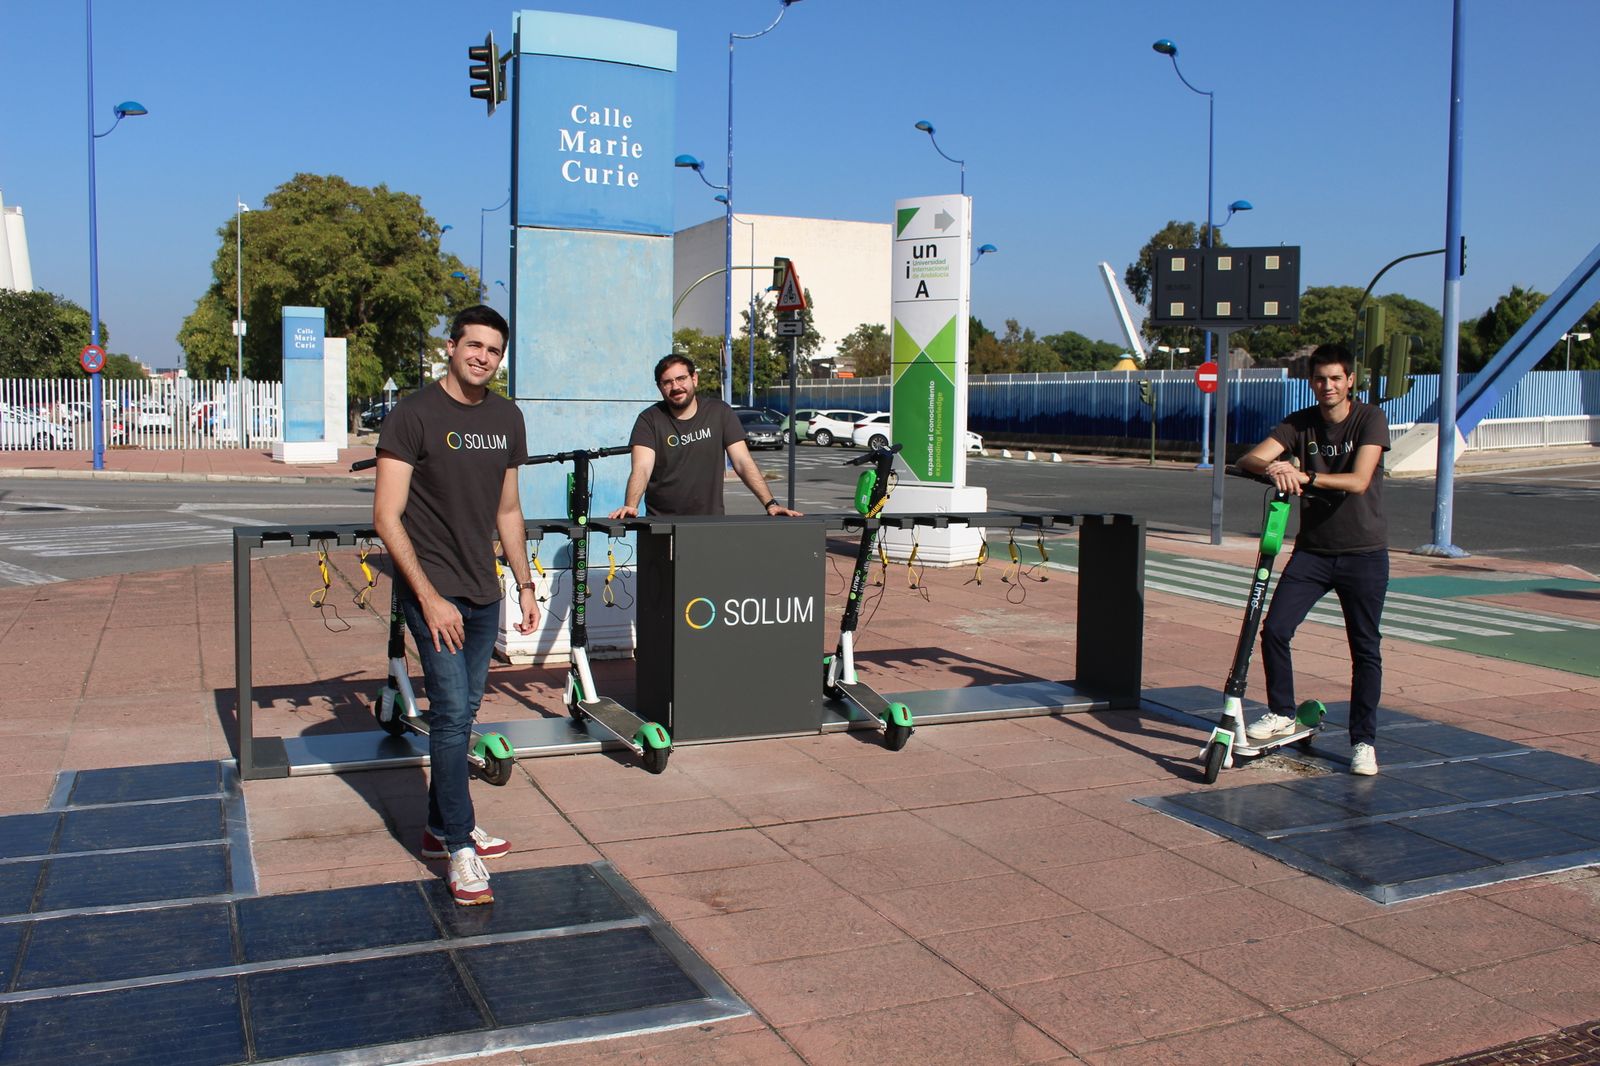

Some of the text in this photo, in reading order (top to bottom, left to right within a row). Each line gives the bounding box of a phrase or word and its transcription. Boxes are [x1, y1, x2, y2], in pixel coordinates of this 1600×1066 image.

[571, 104, 633, 129] Calle
[558, 128, 643, 159] Marie
[561, 159, 640, 188] Curie
[912, 243, 938, 259] un
[912, 258, 947, 266] Universidad
[914, 279, 930, 298] A
[294, 334, 317, 342] Marie
[297, 327, 314, 335] Calle
[295, 341, 316, 349] Curie
[464, 433, 508, 450] SOLUM
[935, 436, 943, 477] expanding
[1250, 581, 1265, 609] Lime
[723, 596, 814, 626] SOLUM
